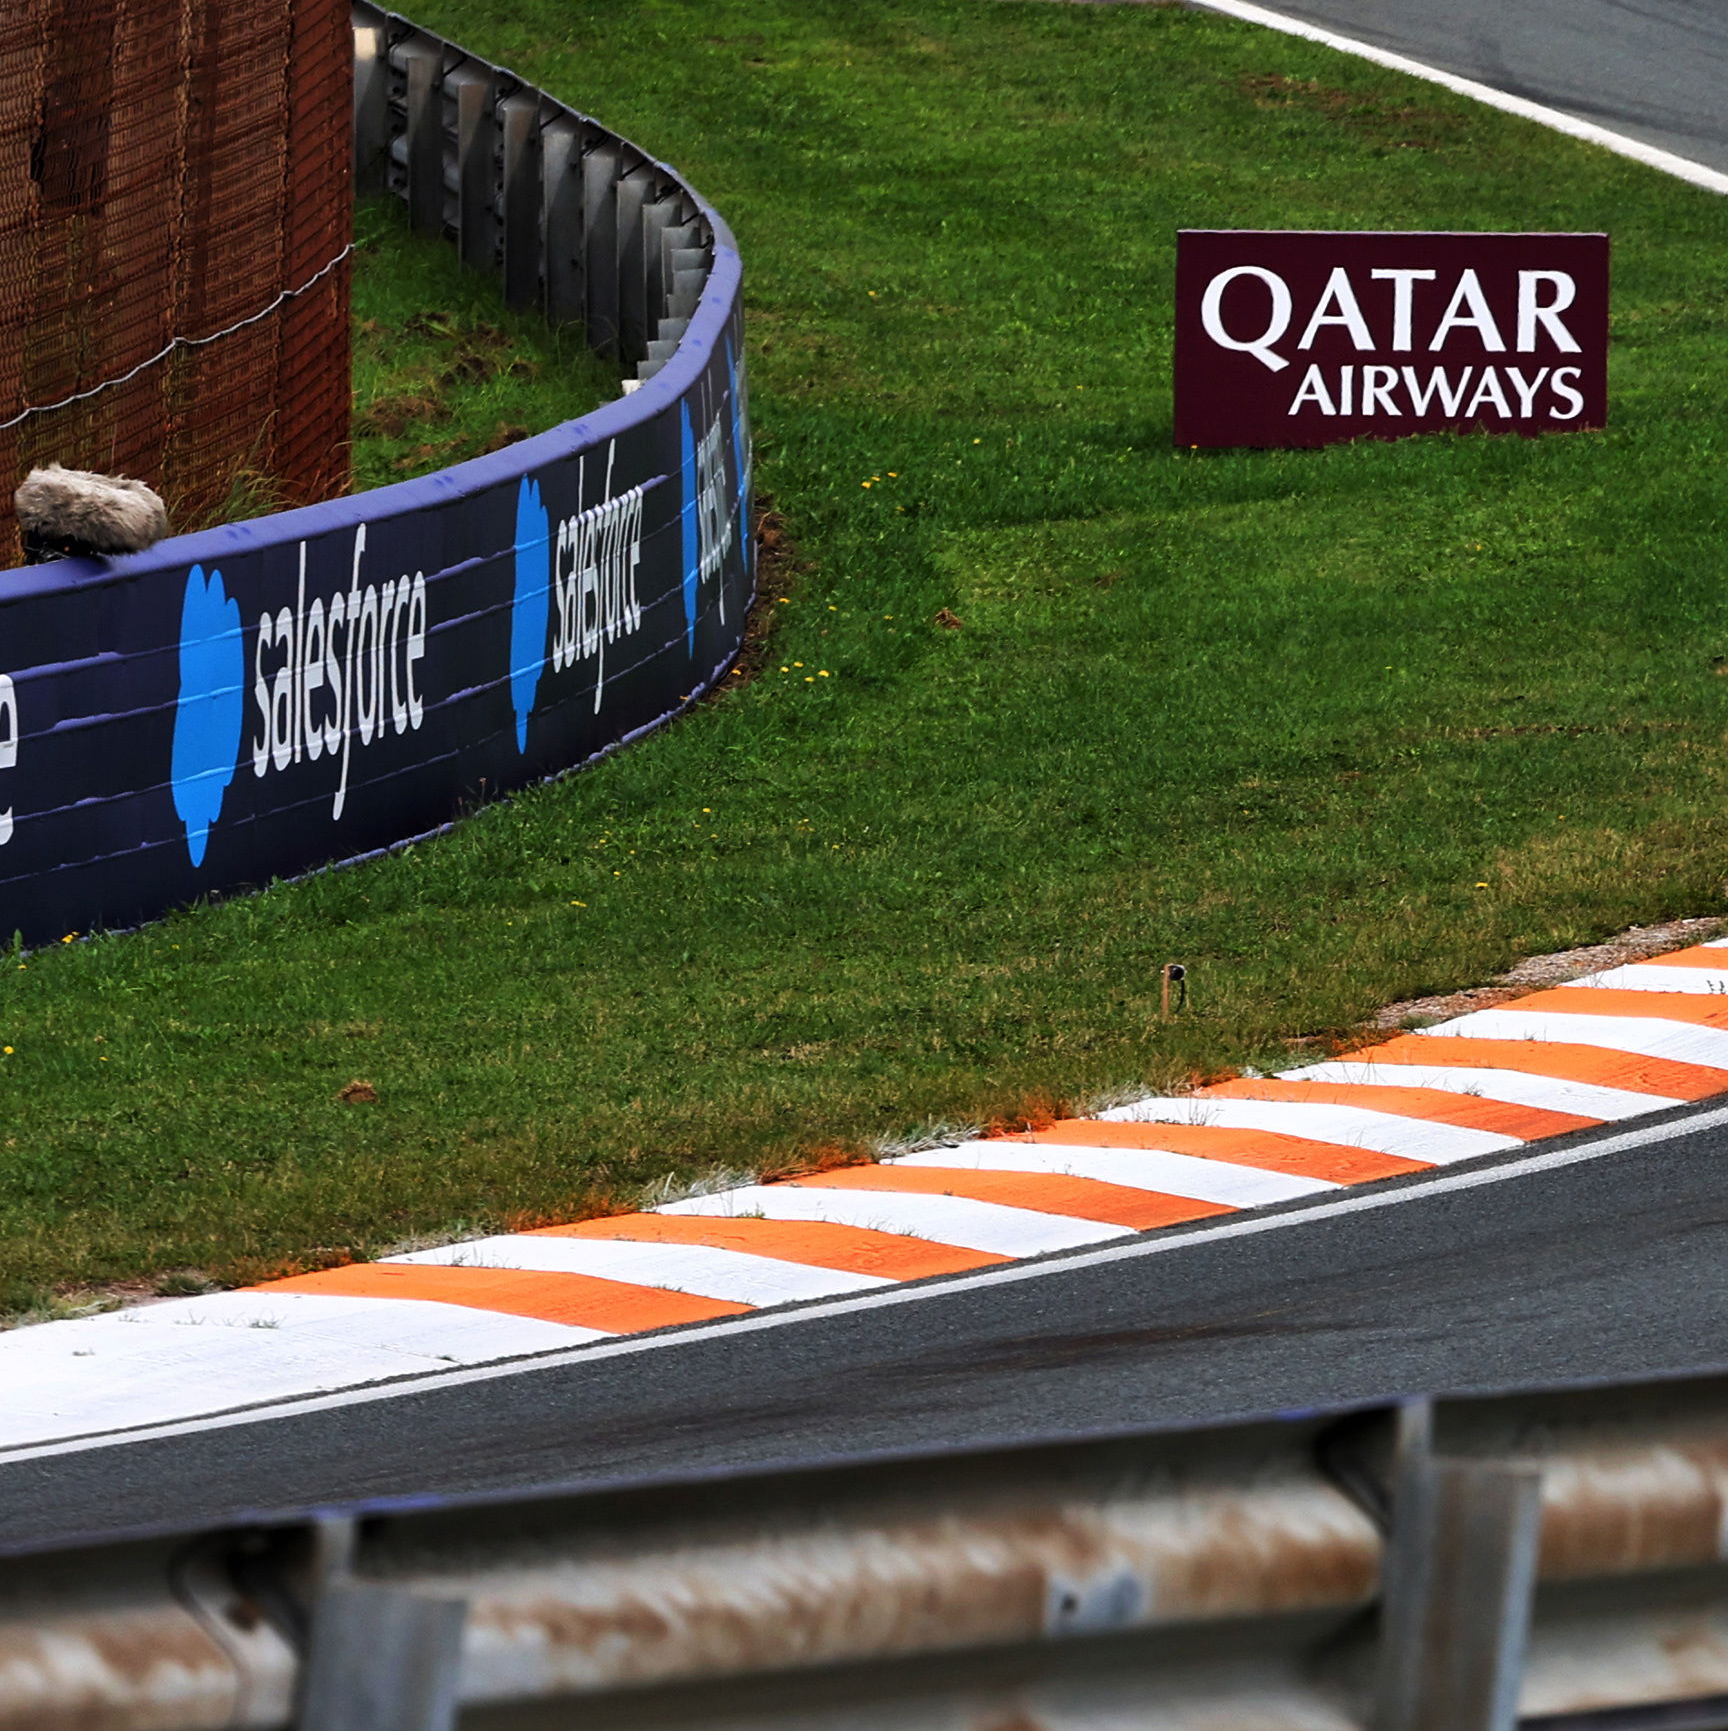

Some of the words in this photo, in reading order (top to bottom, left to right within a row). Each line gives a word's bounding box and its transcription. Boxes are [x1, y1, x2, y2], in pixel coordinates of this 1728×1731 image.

[1201, 265, 1582, 372] QATAR
[1288, 363, 1584, 420] AIRWAYS
[252, 522, 426, 821] salesforce
[552, 439, 643, 715] salesforce
